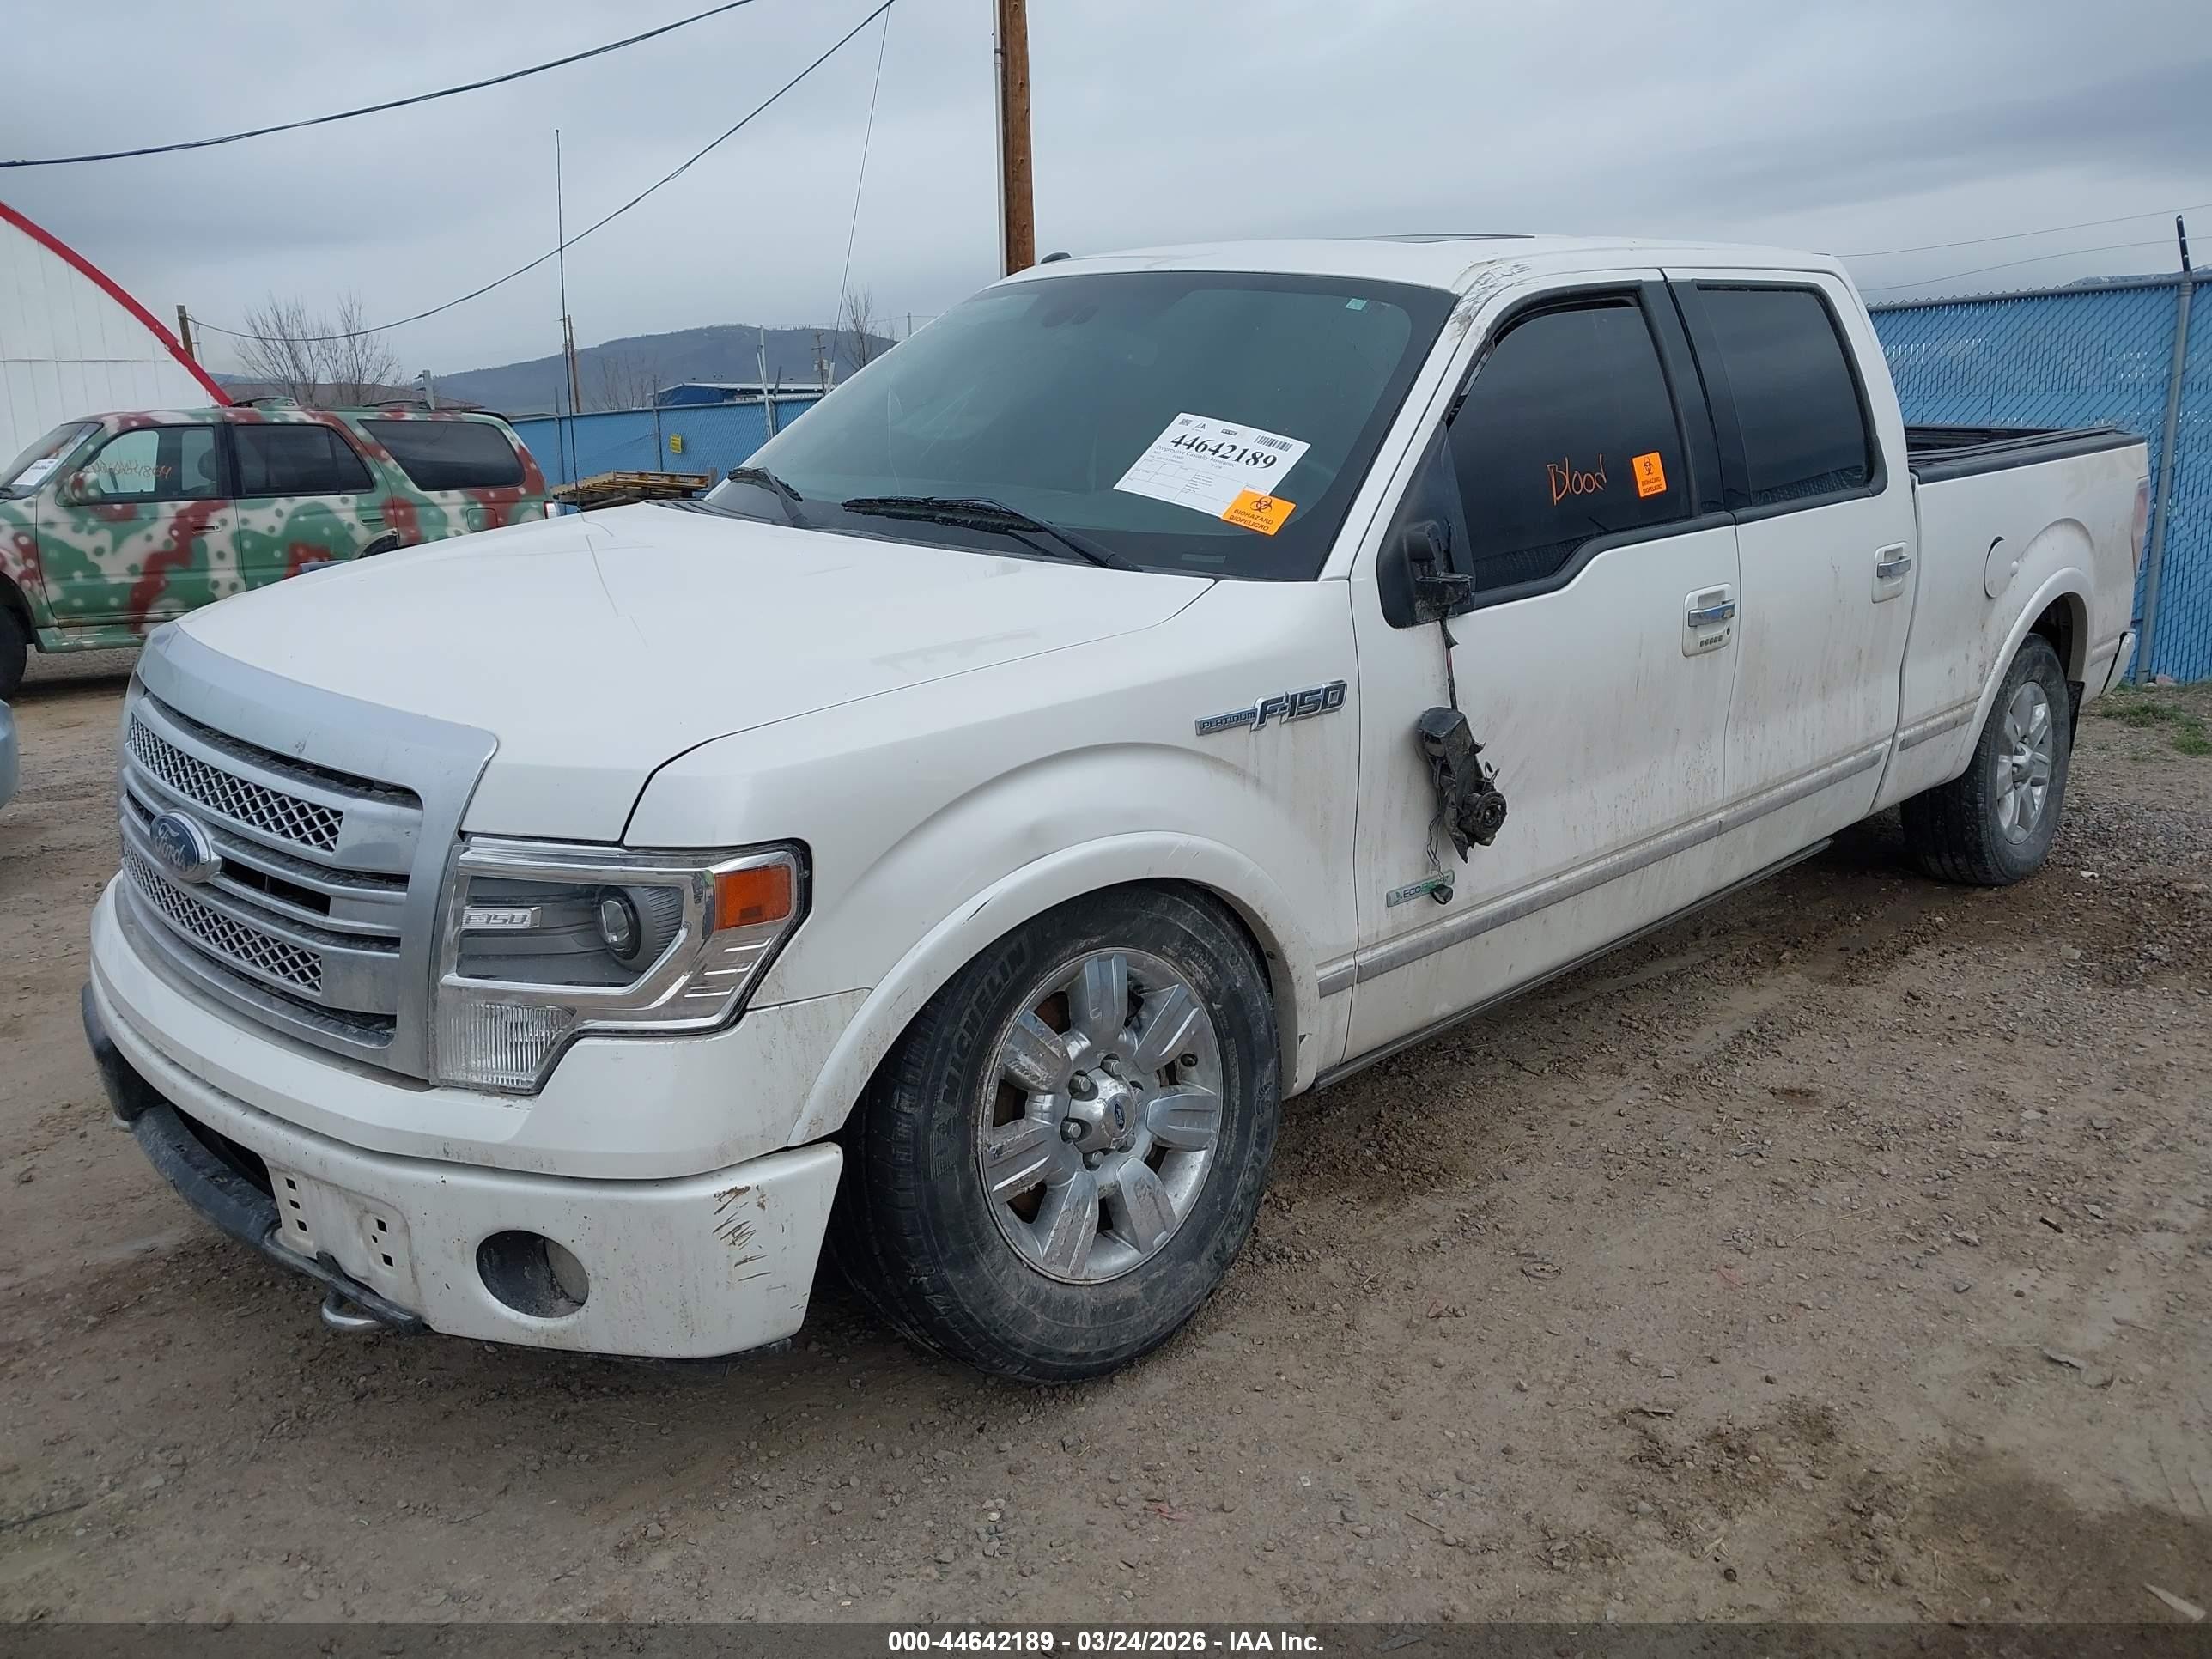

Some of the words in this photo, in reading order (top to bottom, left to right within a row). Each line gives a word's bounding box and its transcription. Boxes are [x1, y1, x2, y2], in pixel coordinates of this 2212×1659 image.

[1170, 433, 1278, 469] 44642189
[1547, 453, 1607, 506] Blood
[1229, 514, 1269, 531] BIOPELIGRO
[1233, 508, 1273, 525] BIOHAZARD
[1201, 711, 1256, 730] PLATINUM
[155, 822, 188, 870] Ford
